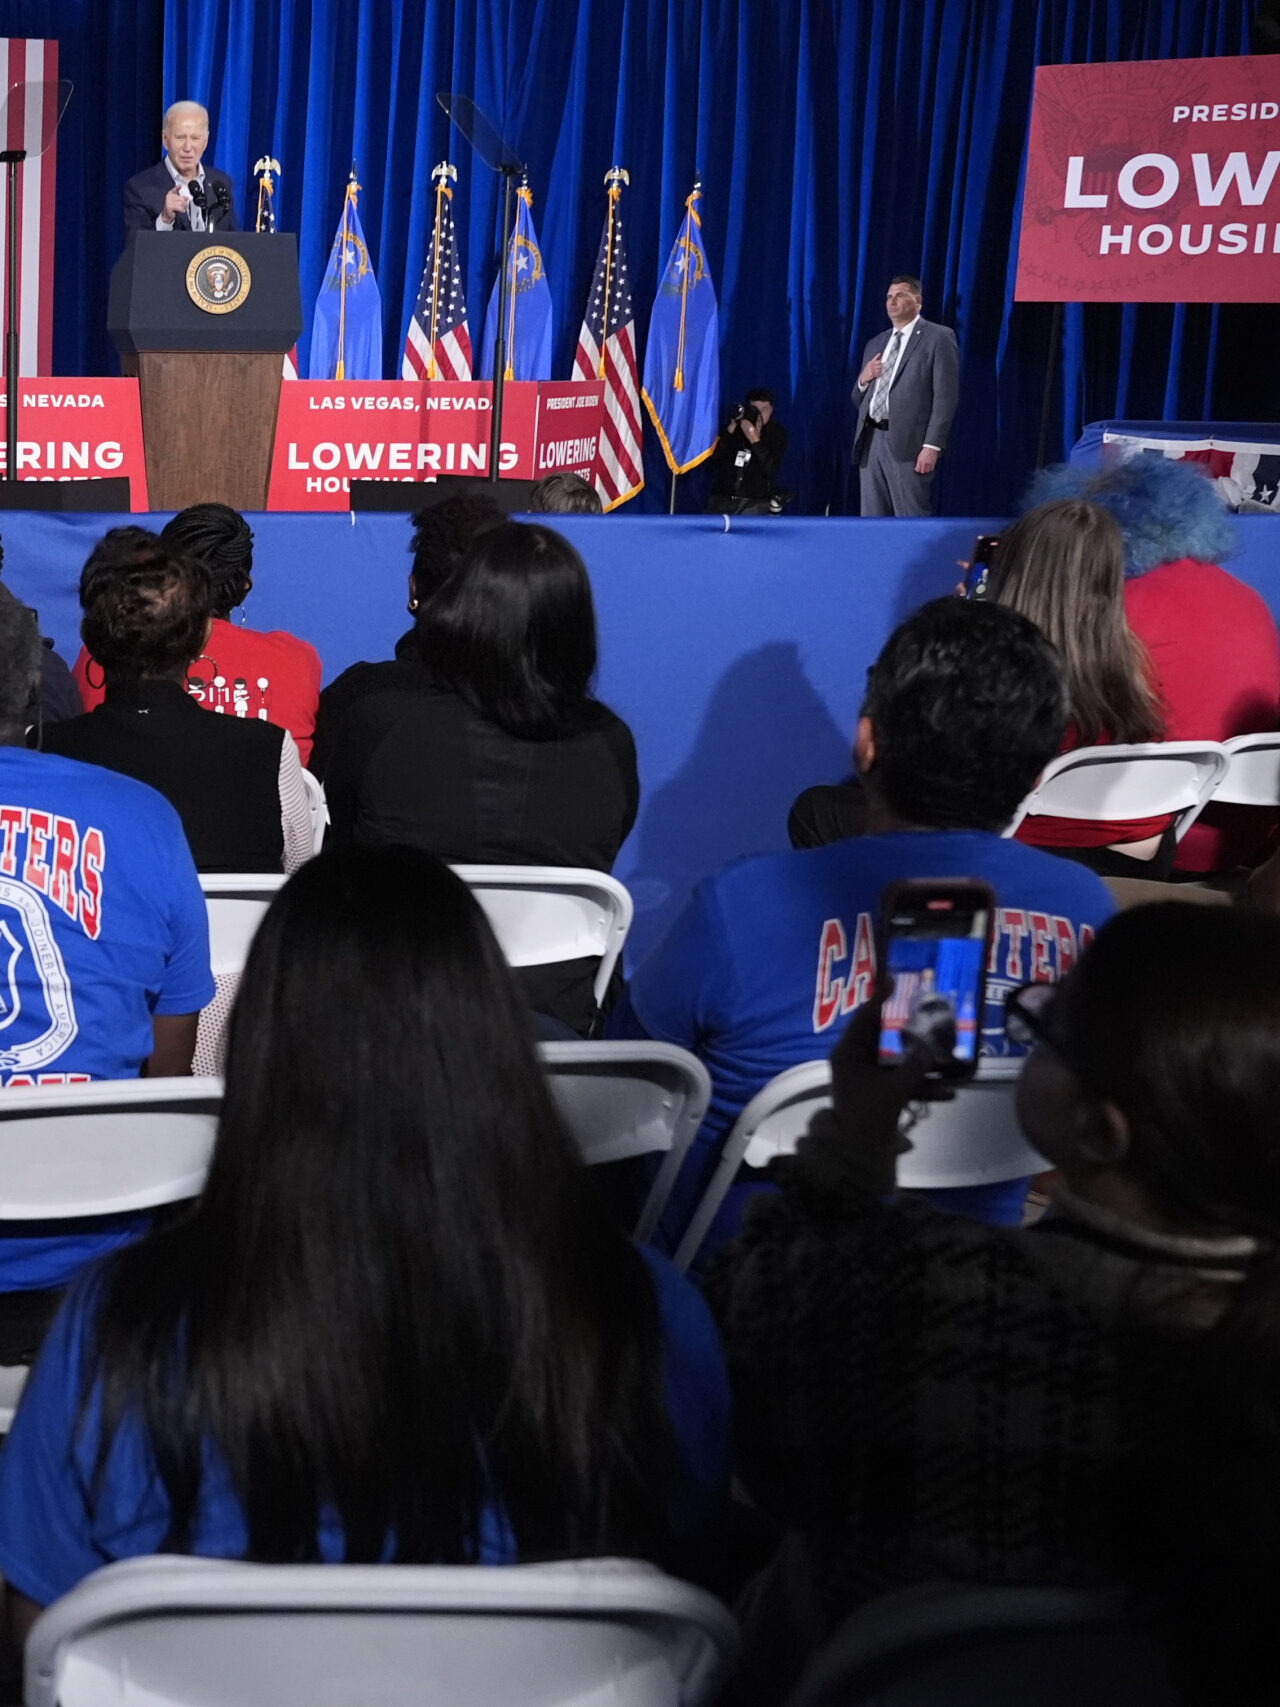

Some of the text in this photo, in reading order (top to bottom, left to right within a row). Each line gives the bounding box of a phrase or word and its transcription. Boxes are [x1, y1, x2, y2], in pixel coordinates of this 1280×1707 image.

[1099, 223, 1280, 255] HOUSI
[22, 394, 105, 408] NEVADA
[309, 396, 494, 412] LAS VEGAS, NEVAD
[546, 397, 576, 410] PRESIDENT
[287, 442, 519, 471] LOWERING
[539, 436, 597, 469] LOWERING
[36, 1002, 71, 1057] AMERICA
